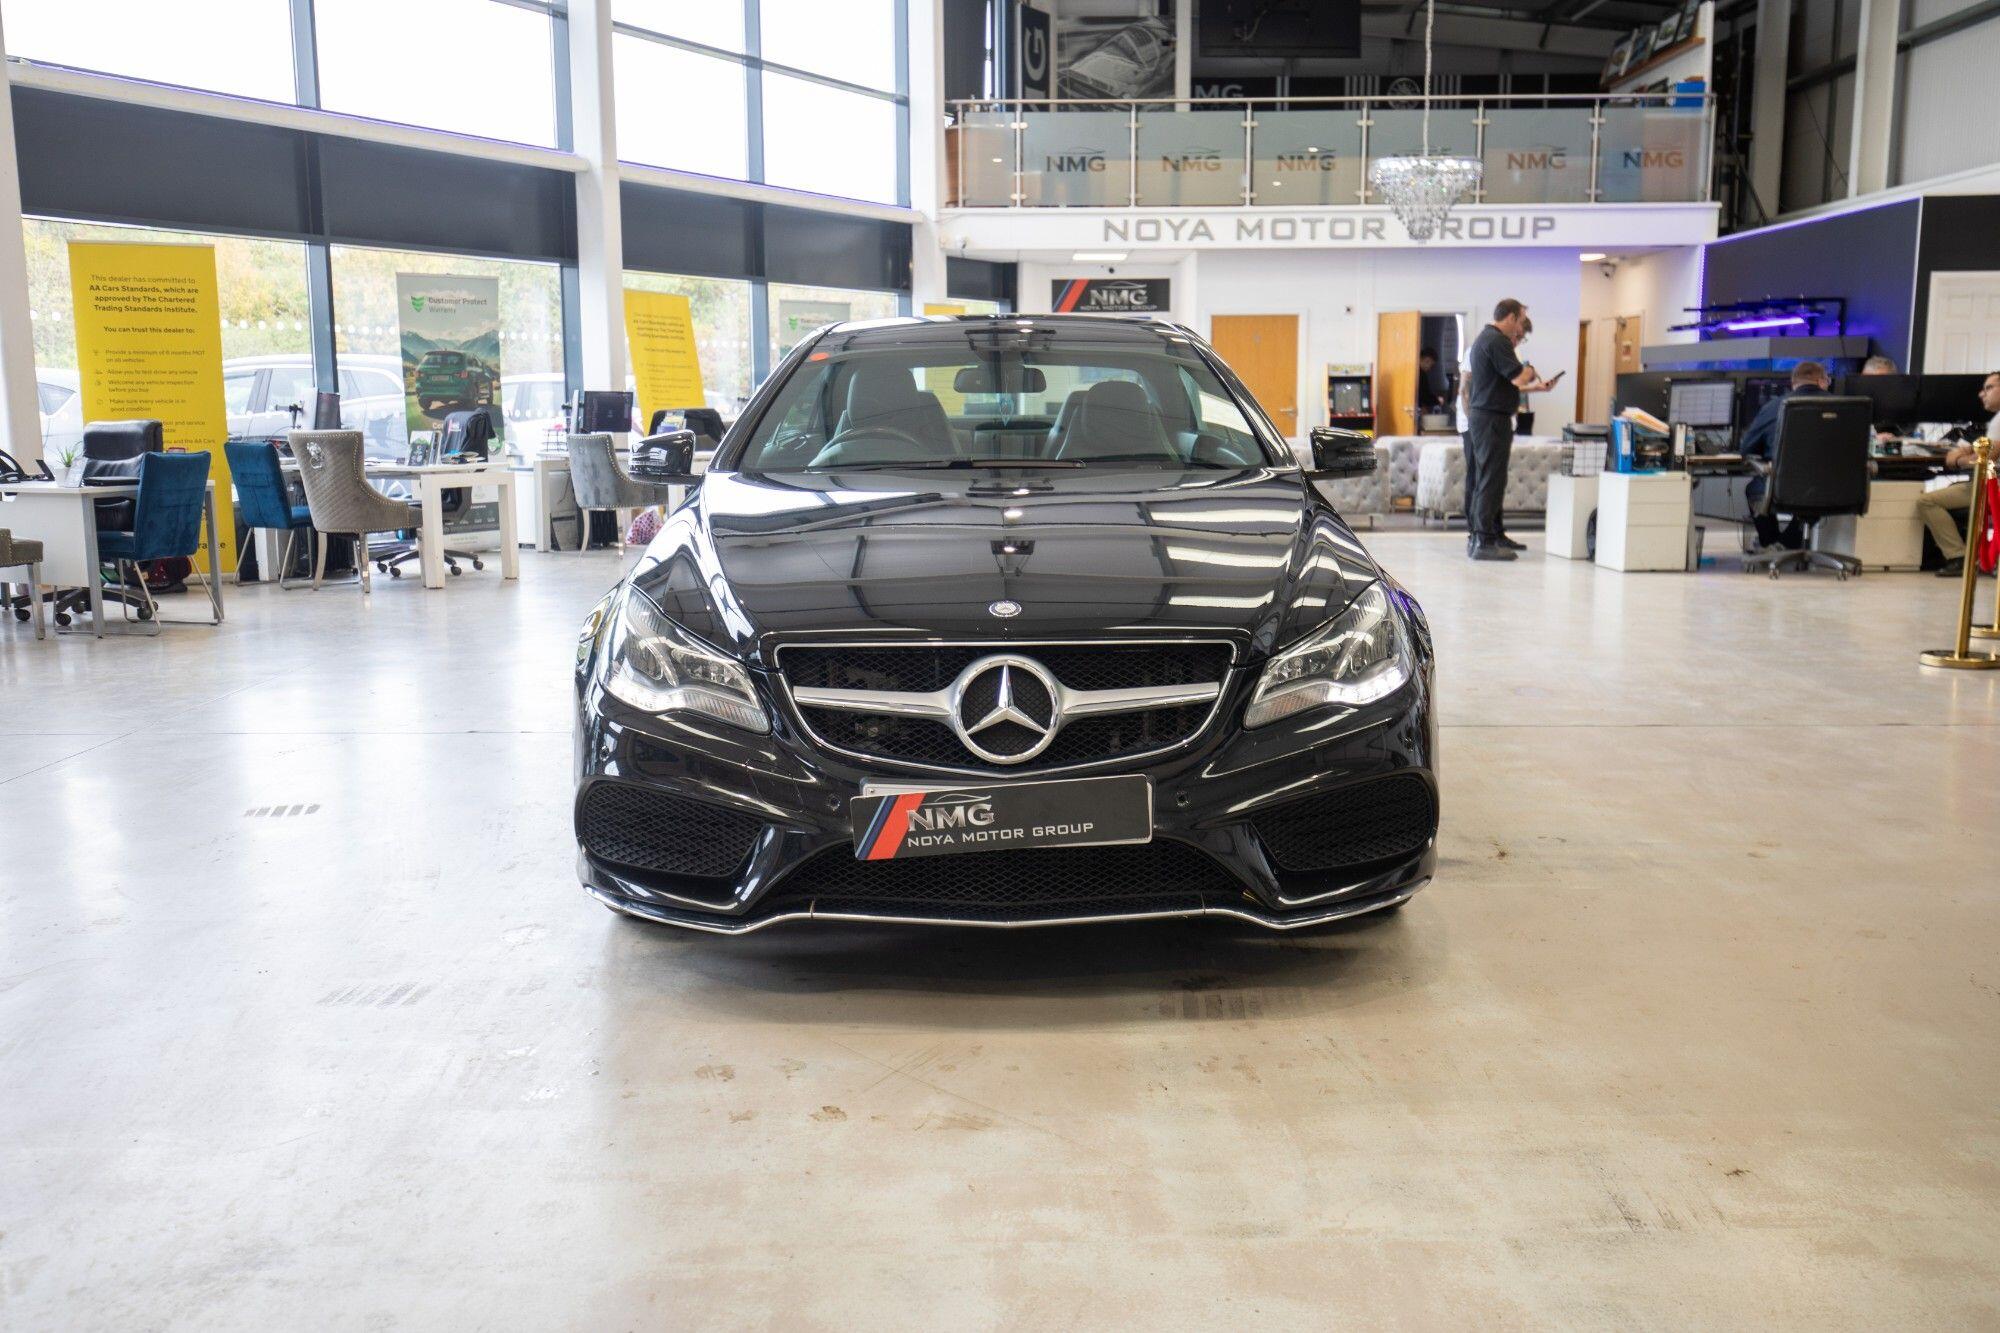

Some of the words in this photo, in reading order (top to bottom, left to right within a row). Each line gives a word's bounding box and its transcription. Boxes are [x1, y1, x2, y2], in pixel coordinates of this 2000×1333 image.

[1046, 155, 1106, 172] NMG
[1162, 155, 1222, 172] NMG
[1276, 154, 1337, 171] NMG
[1506, 153, 1567, 170] NMG
[1623, 151, 1684, 169] NMG
[1104, 218, 1215, 242] NOYA
[1236, 218, 1386, 241] MOTOR
[148, 276, 187, 284] committed
[132, 295, 141, 304] by
[1090, 289, 1148, 306] NMG
[93, 304, 123, 313] Trading
[124, 305, 163, 313] Standards
[163, 326, 184, 334] dealer
[906, 803, 995, 832] NMG
[907, 835, 954, 848] NOYA
[962, 828, 1024, 842] MOTOR
[1032, 822, 1094, 837] GROUP
